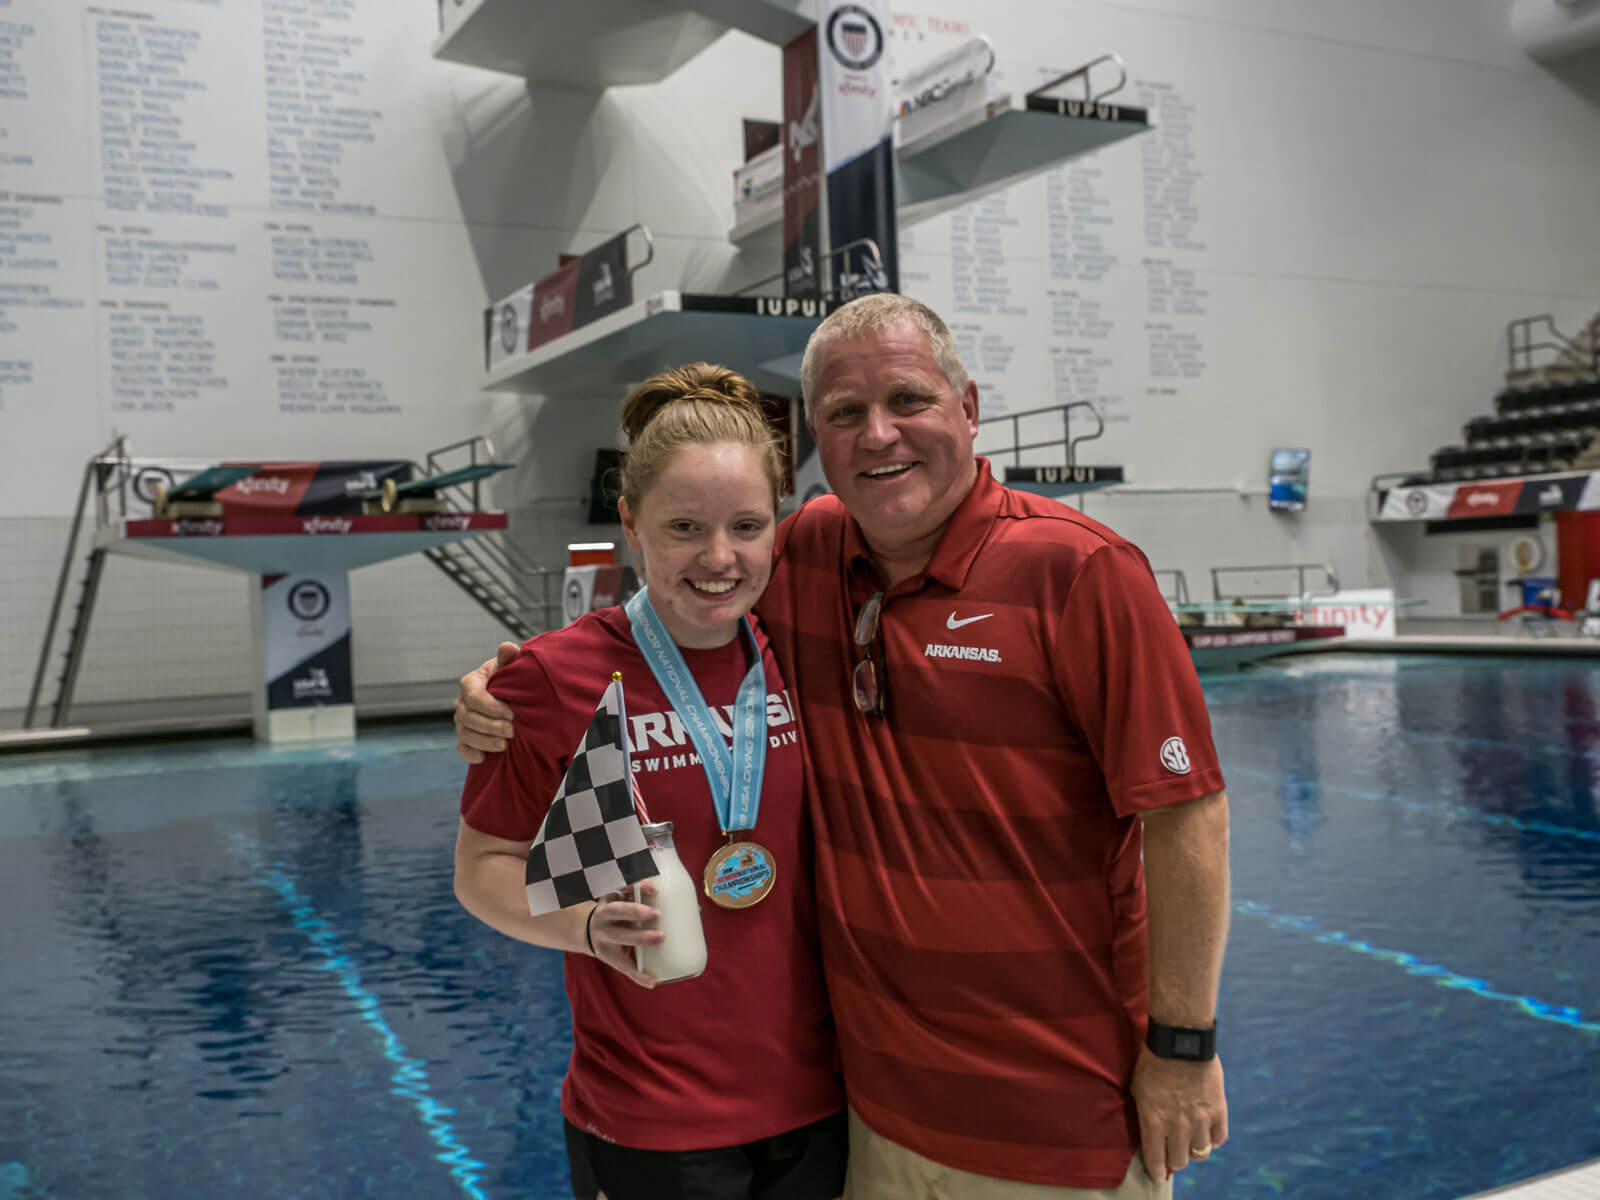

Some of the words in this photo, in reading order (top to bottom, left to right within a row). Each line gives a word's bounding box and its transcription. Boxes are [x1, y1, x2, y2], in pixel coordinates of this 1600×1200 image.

[1058, 100, 1119, 121] IUPUI
[757, 297, 827, 317] IUPUI
[1036, 467, 1096, 483] IUPUI
[656, 648, 689, 704] NATIONAL
[685, 703, 731, 798] CHAMPIONSHIPS
[743, 740, 755, 783] DIVING
[713, 869, 771, 894] CHAMPIONSHIPS
